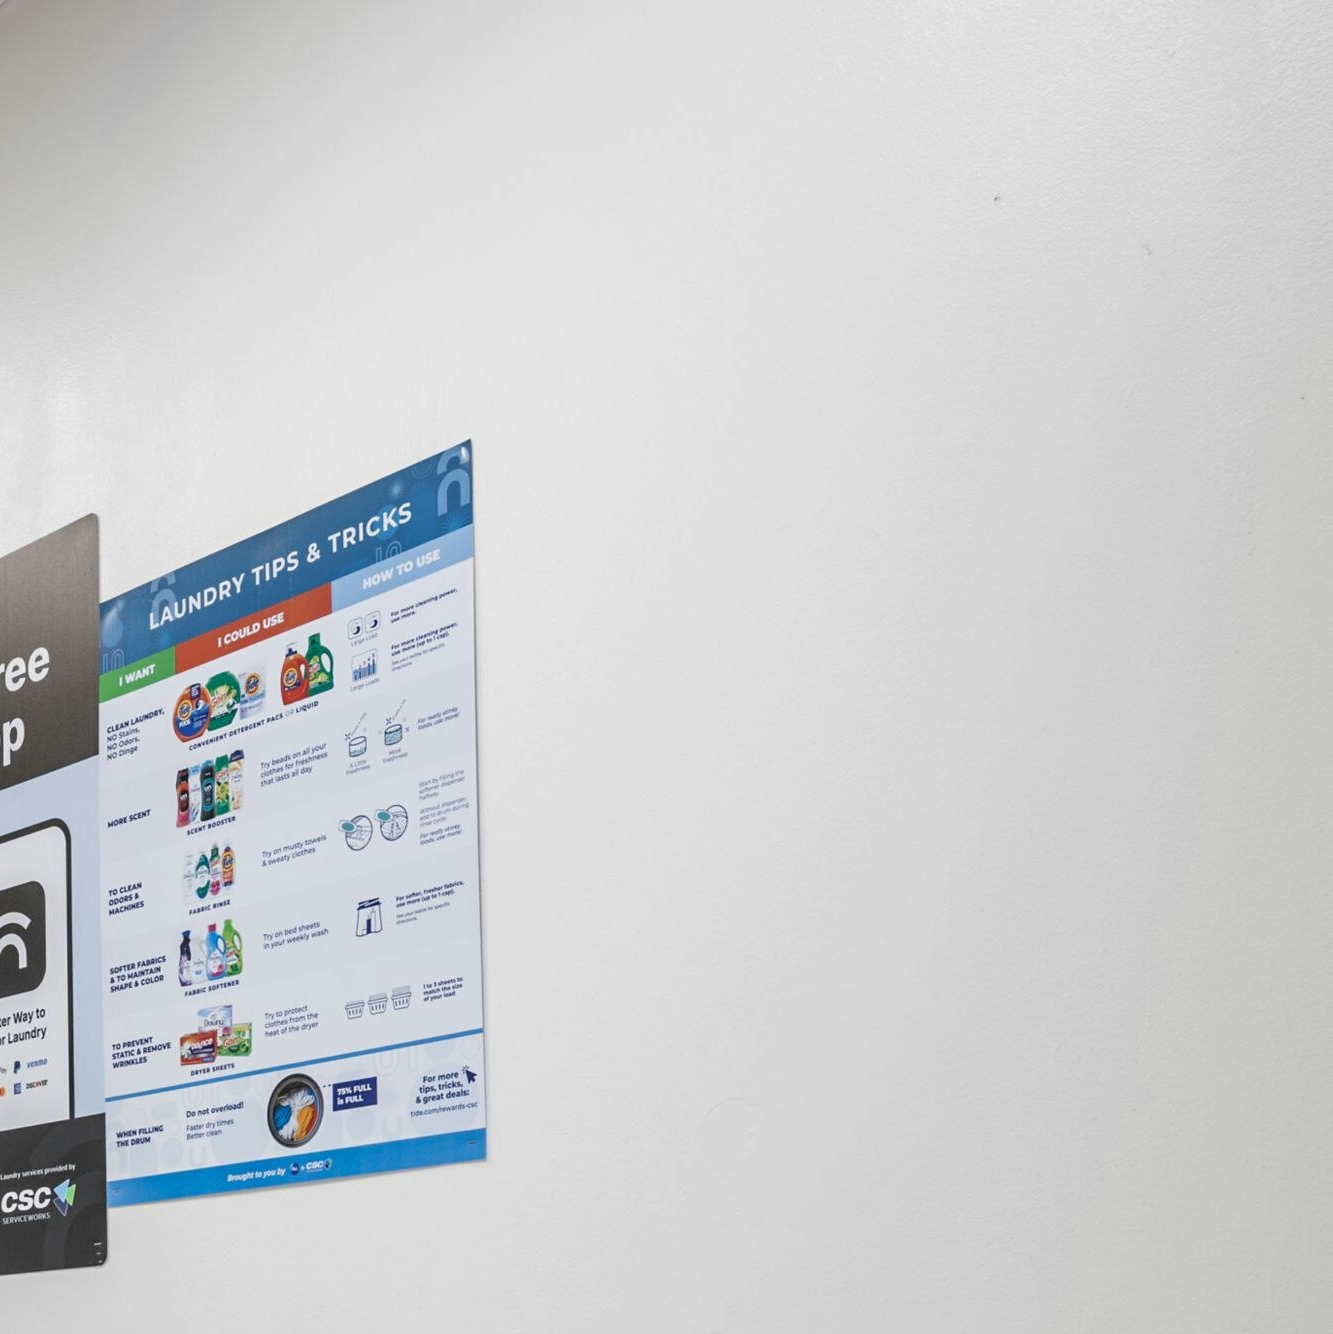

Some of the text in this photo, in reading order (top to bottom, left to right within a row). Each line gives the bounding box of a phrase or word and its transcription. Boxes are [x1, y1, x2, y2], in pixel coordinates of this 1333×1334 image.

[150, 502, 412, 631] LAUNDRY TIPS & TRICKS
[363, 550, 441, 589] HOW TO USE
[218, 613, 285, 647] I COULD USE
[119, 664, 156, 687] I WANT
[107, 708, 164, 733] CLEAN LAUNDRY,
[189, 733, 227, 751] CONVENIENT
[229, 720, 265, 737] DETERGENT
[267, 713, 283, 724] PACS
[296, 705, 319, 717] LIQUID
[107, 810, 151, 828] MORE SCENT
[119, 882, 142, 894] CLEAN
[108, 894, 132, 906] ODORS
[109, 901, 144, 915] MACHINES
[13, 1009, 34, 1024] Way
[36, 1008, 46, 1019] to
[8, 1027, 47, 1044] Laundry
[423, 1072, 458, 1083] For more
[419, 1080, 463, 1094] tips, tricks,
[423, 1092, 444, 1104] great
[446, 1089, 470, 1099] deals:
[187, 1102, 244, 1118] Do not overload!
[116, 1125, 163, 1139] WHEN FILLING
[116, 1137, 150, 1148] THE DRUM
[0, 1163, 75, 1181] Laundry services provided by
[1, 1187, 51, 1213] CSC
[3, 1213, 50, 1225] SERVICEWORKS
